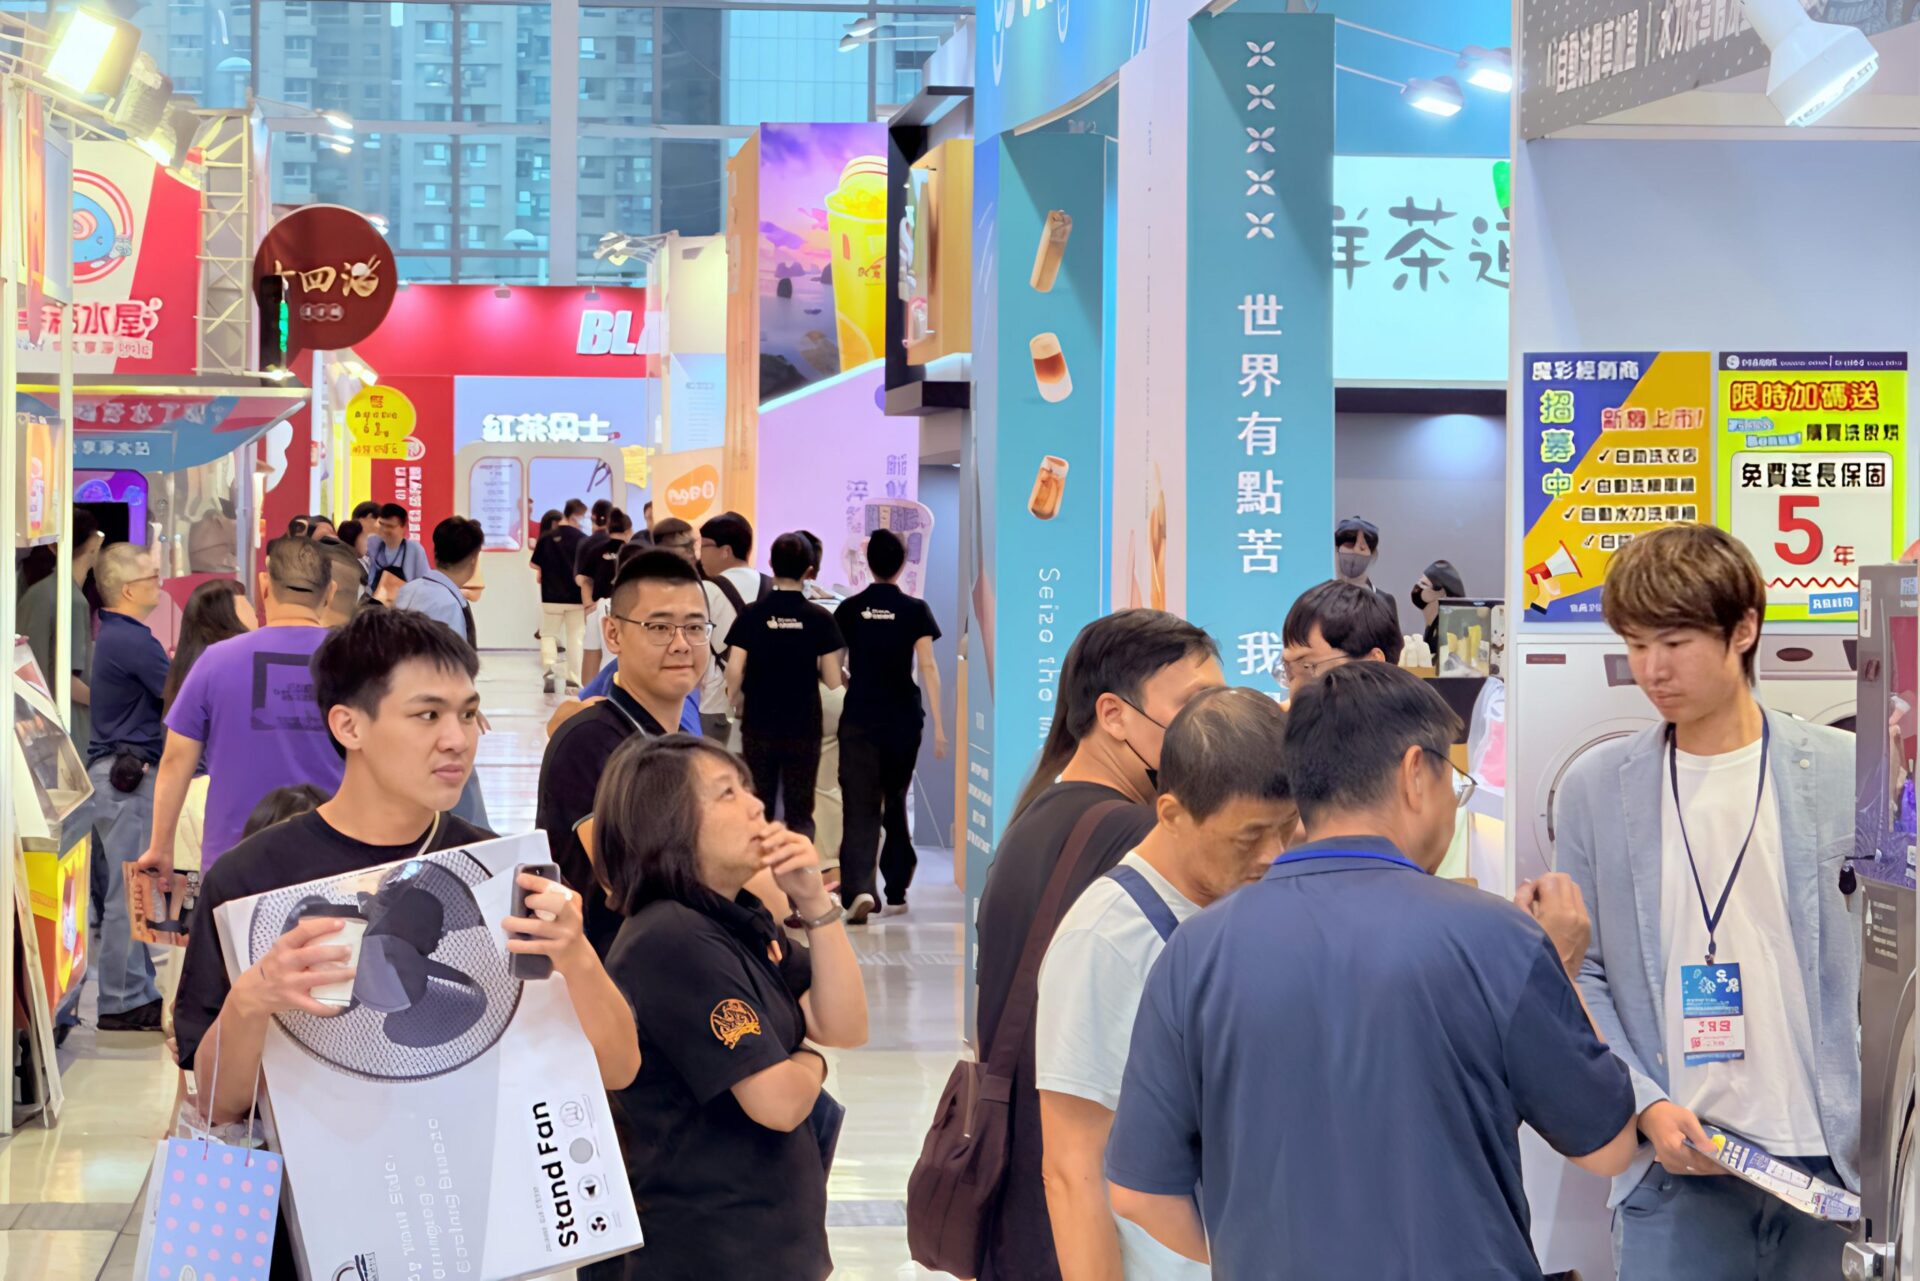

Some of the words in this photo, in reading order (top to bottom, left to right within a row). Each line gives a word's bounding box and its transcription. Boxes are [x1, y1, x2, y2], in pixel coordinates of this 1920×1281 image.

[1730, 380, 1879, 411] 限時加碼送
[1237, 294, 1283, 573] 世界有點苦
[1741, 462, 1886, 488] 免費延長保固
[1774, 495, 1823, 565] 5
[1834, 545, 1855, 566] 年
[1237, 631, 1283, 675] 我
[532, 1101, 558, 1155] Fan
[541, 1160, 579, 1247] Stand
